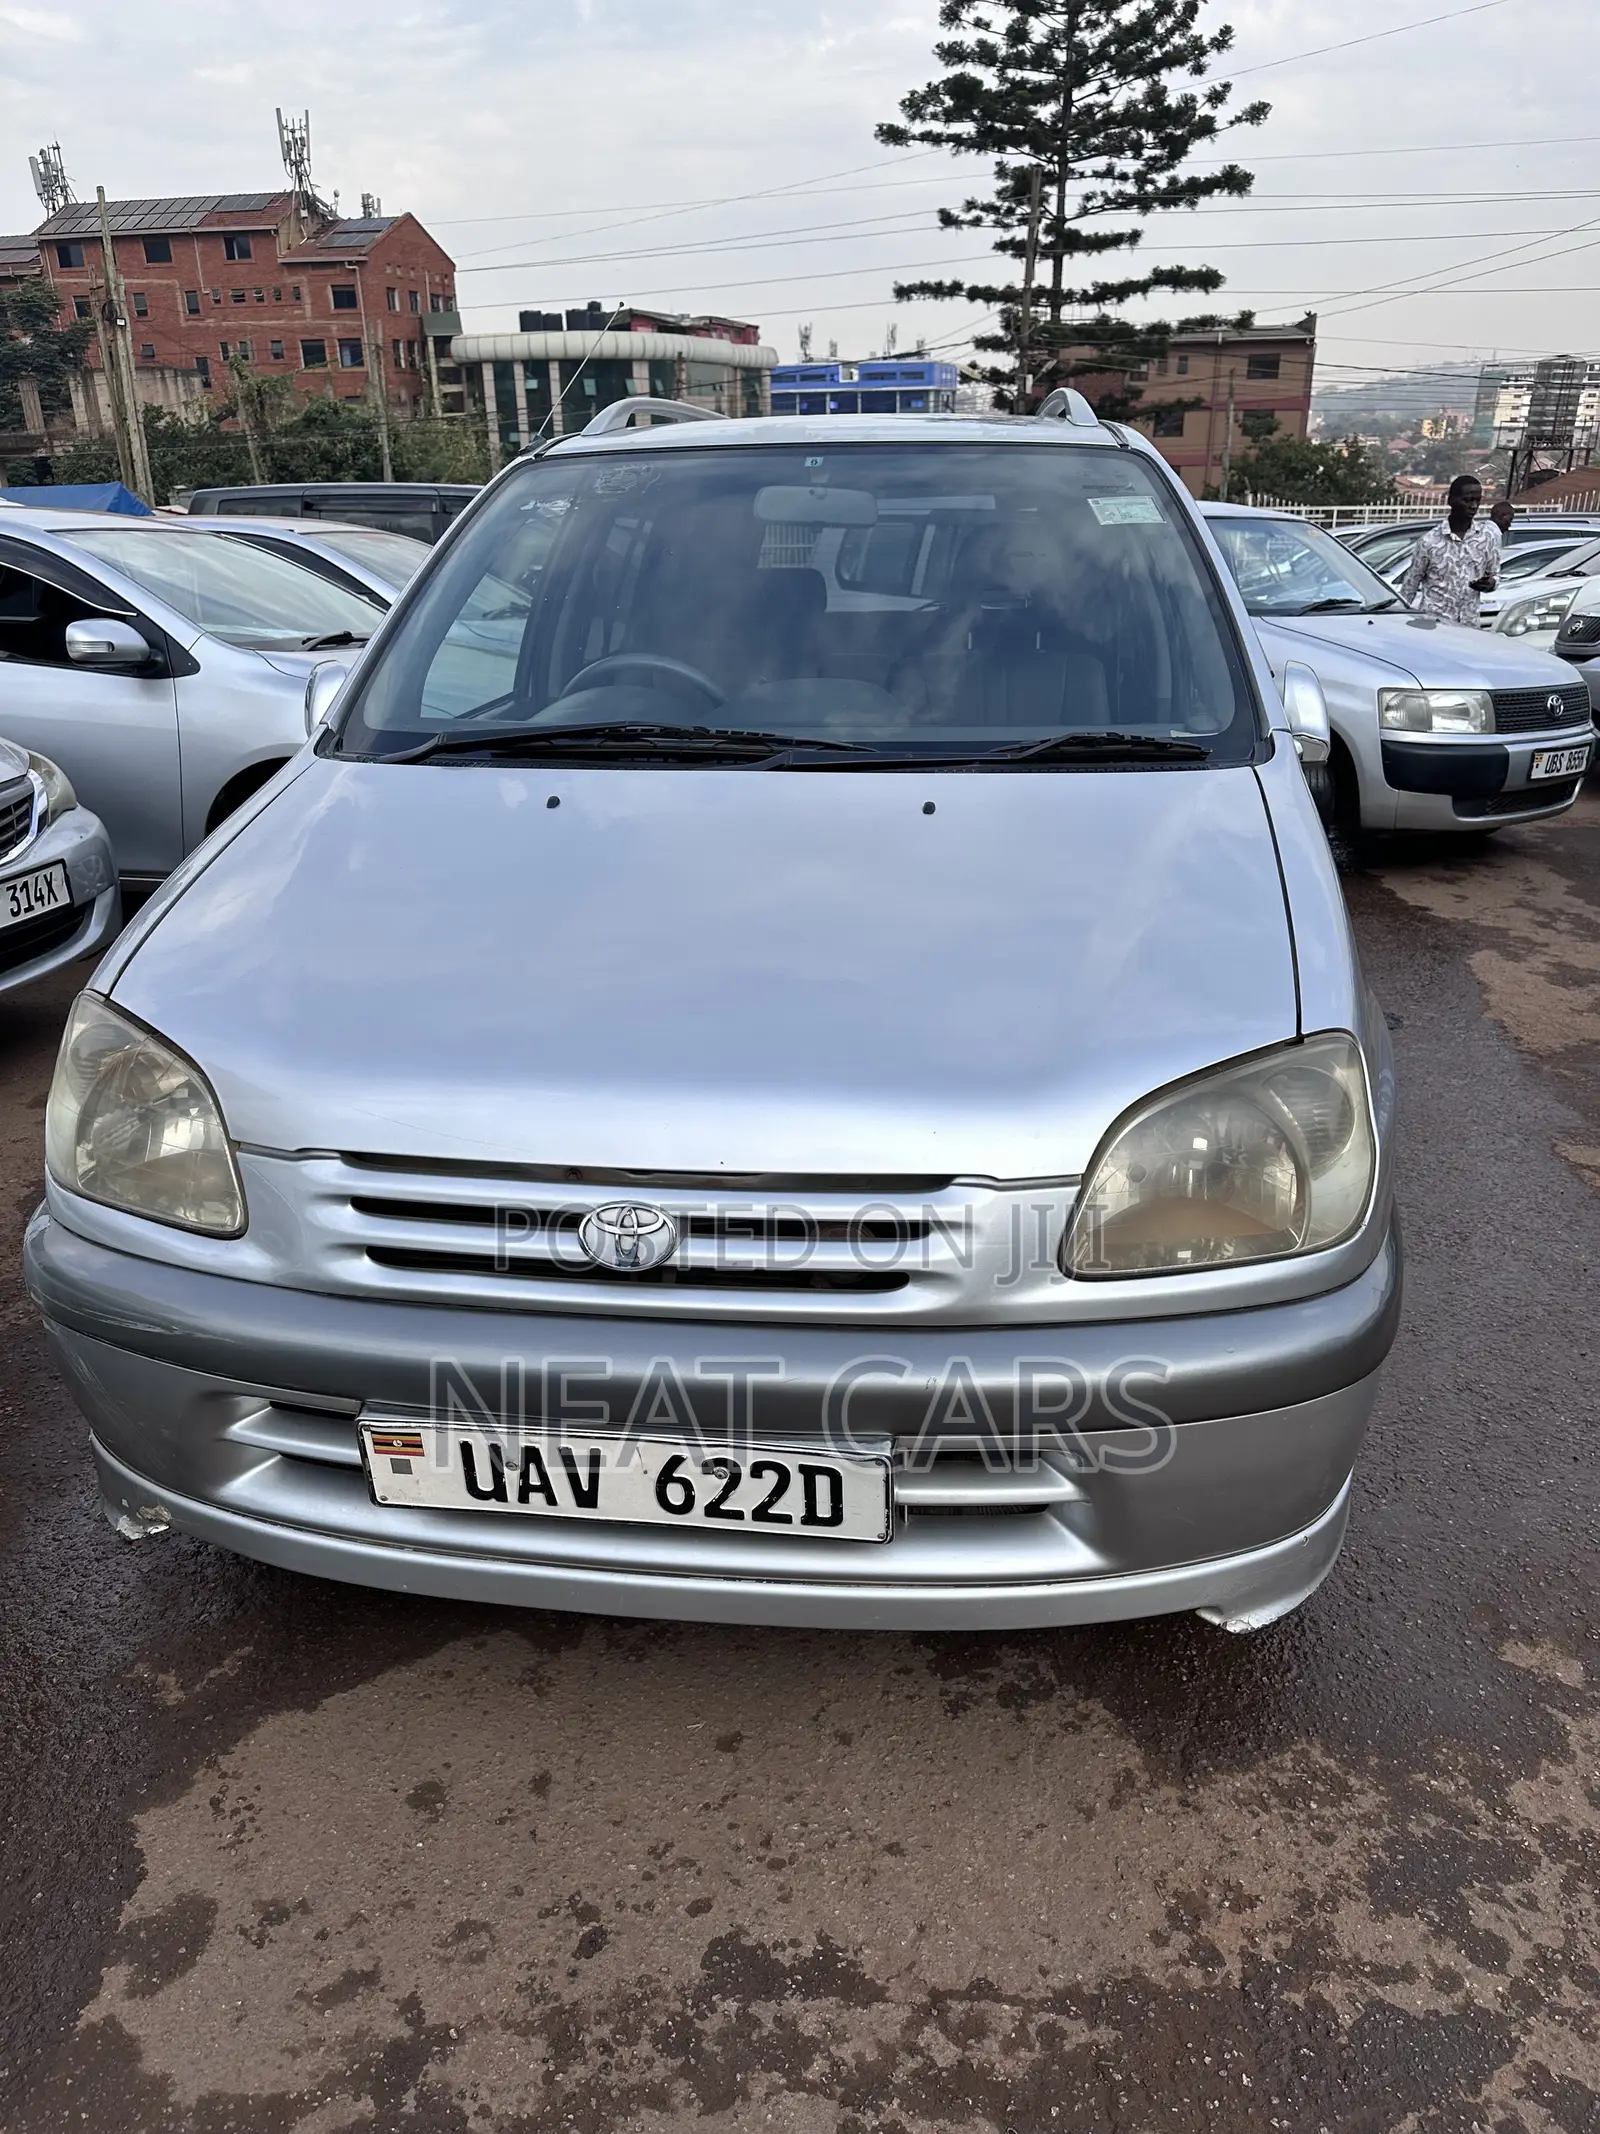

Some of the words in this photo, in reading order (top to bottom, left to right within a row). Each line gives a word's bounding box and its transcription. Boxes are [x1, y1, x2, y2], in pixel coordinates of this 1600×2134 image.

[1544, 752, 1565, 774] UBS
[5, 871, 59, 918] 314X
[459, 1439, 602, 1509] UAV
[654, 1453, 845, 1528] 622D
